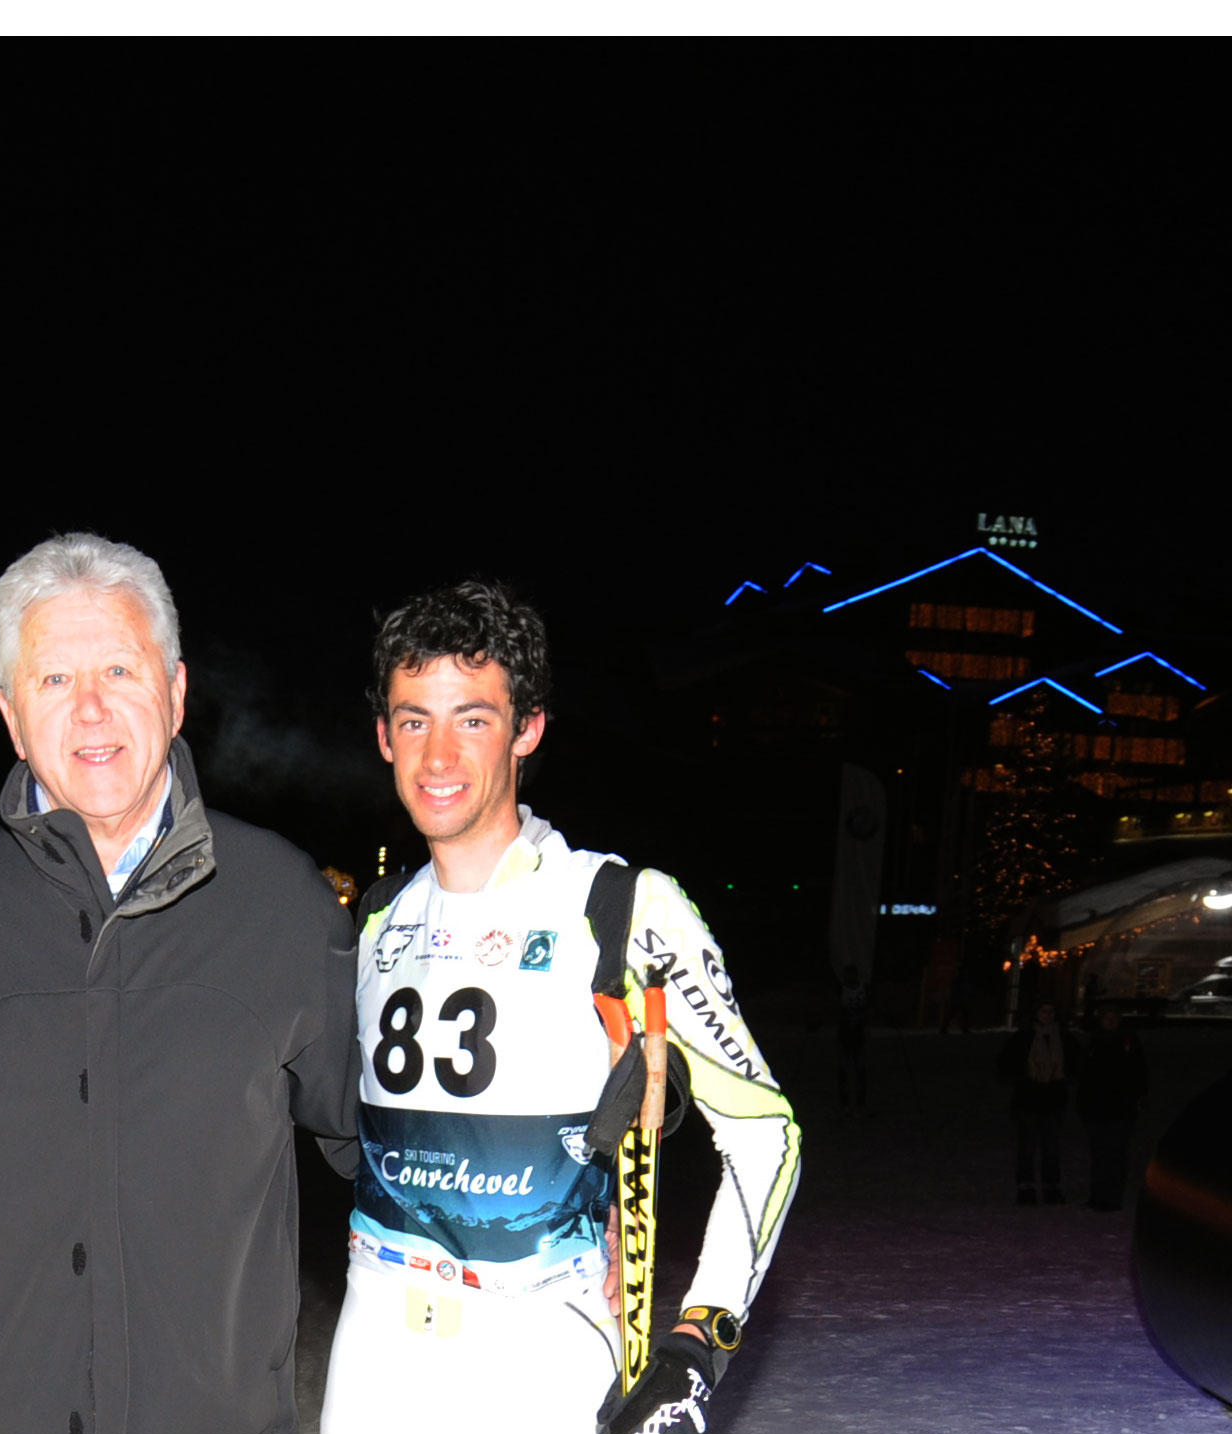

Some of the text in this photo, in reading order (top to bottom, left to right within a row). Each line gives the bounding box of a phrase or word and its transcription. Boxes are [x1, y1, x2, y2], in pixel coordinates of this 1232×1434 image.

[977, 513, 1038, 535] LANA
[634, 928, 760, 1081] SALOMON
[373, 987, 497, 1097] 83
[381, 1151, 534, 1196] Courchevel
[404, 1149, 456, 1166] SKI TOURING
